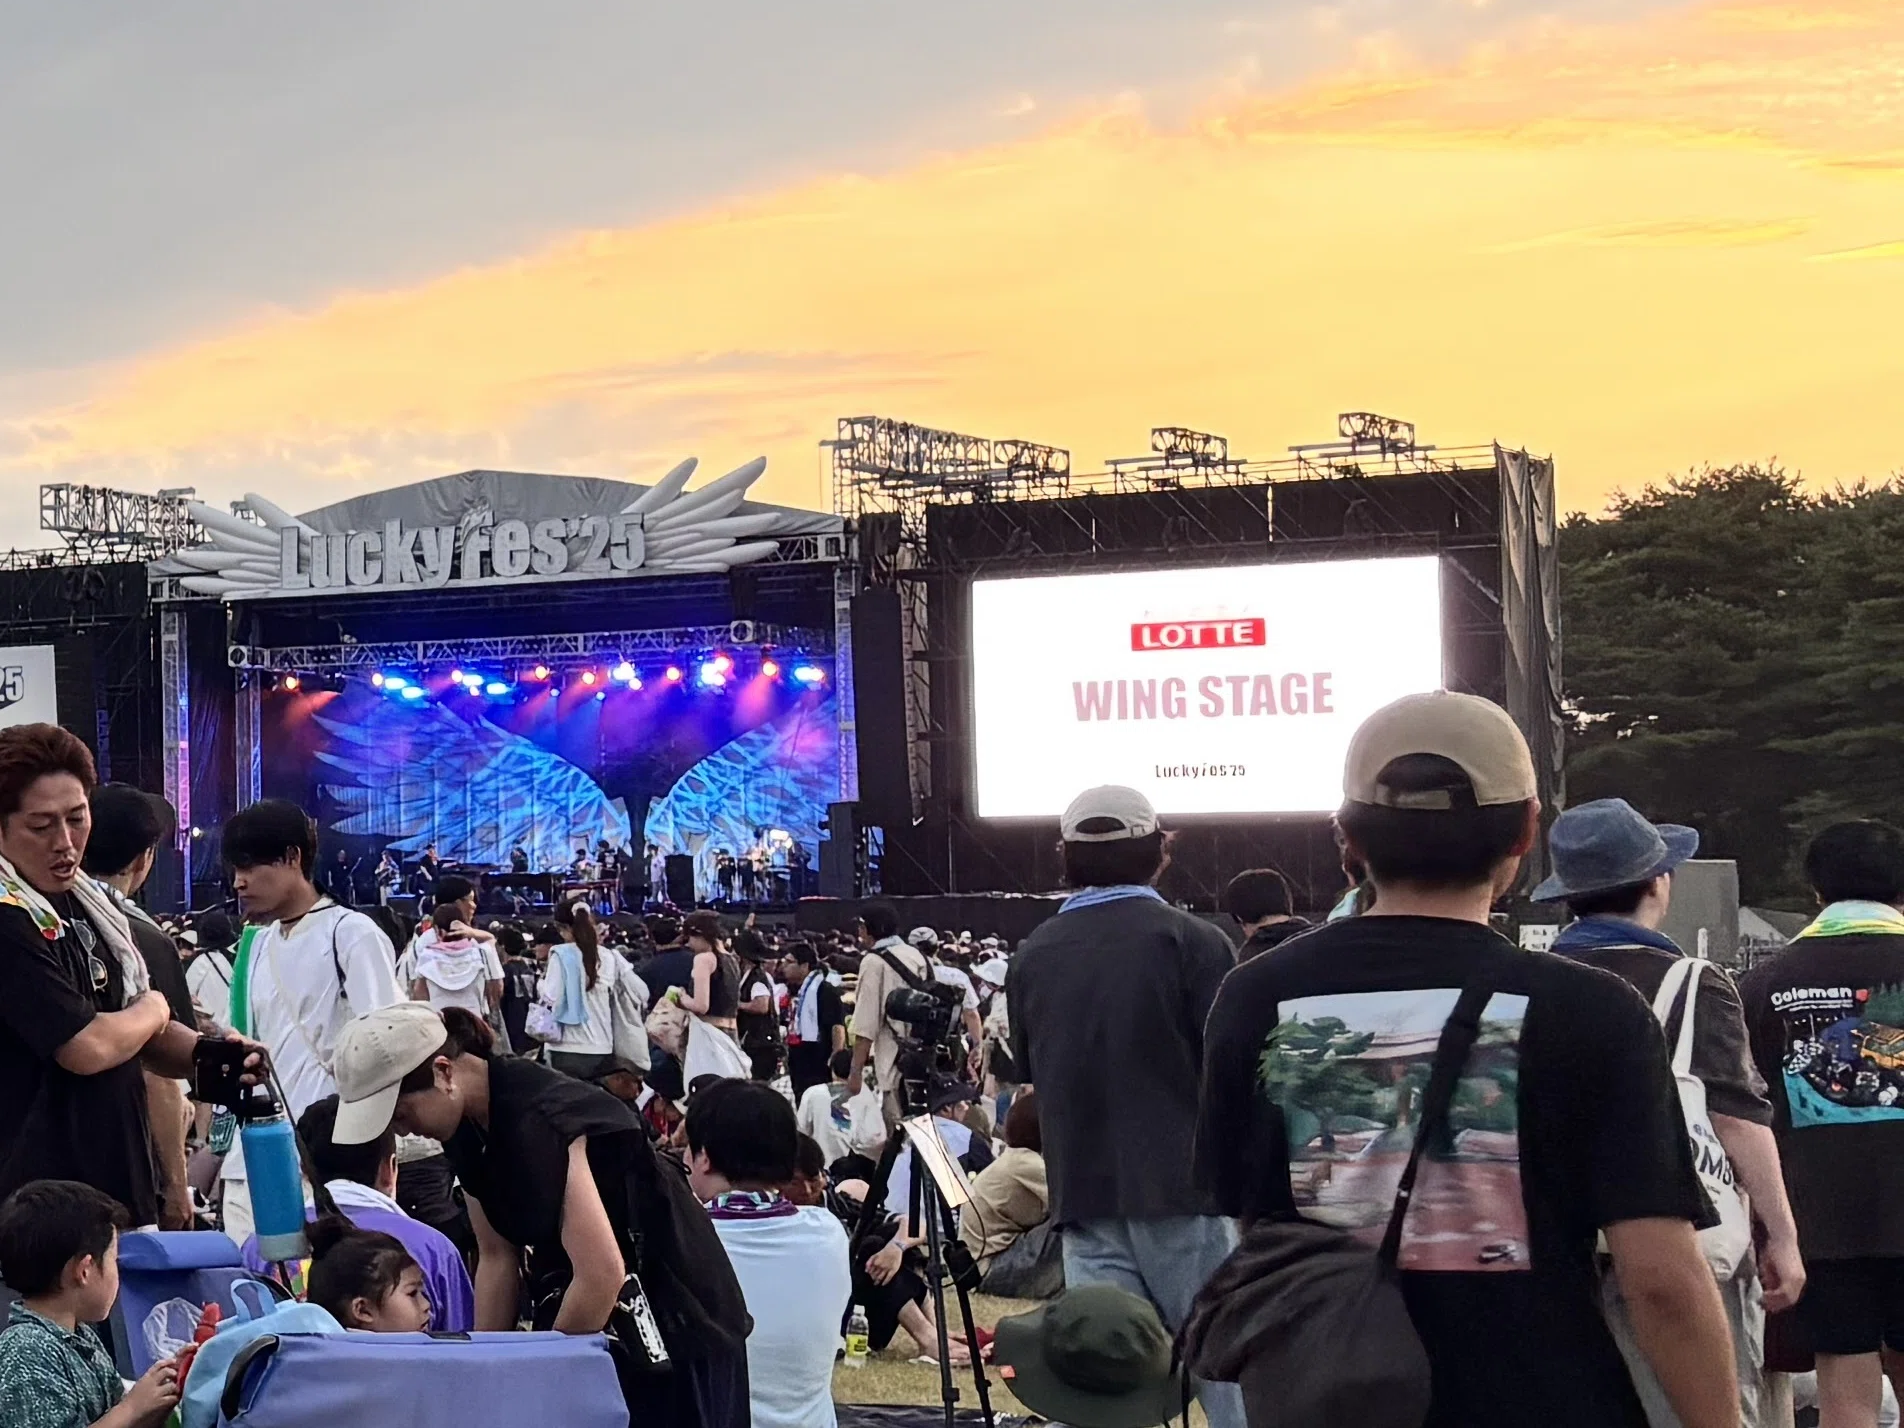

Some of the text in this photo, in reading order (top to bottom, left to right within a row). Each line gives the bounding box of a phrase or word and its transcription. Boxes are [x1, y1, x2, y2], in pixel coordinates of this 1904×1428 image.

[1142, 621, 1254, 648] LOTTE
[1072, 672, 1334, 722] WING STAGE
